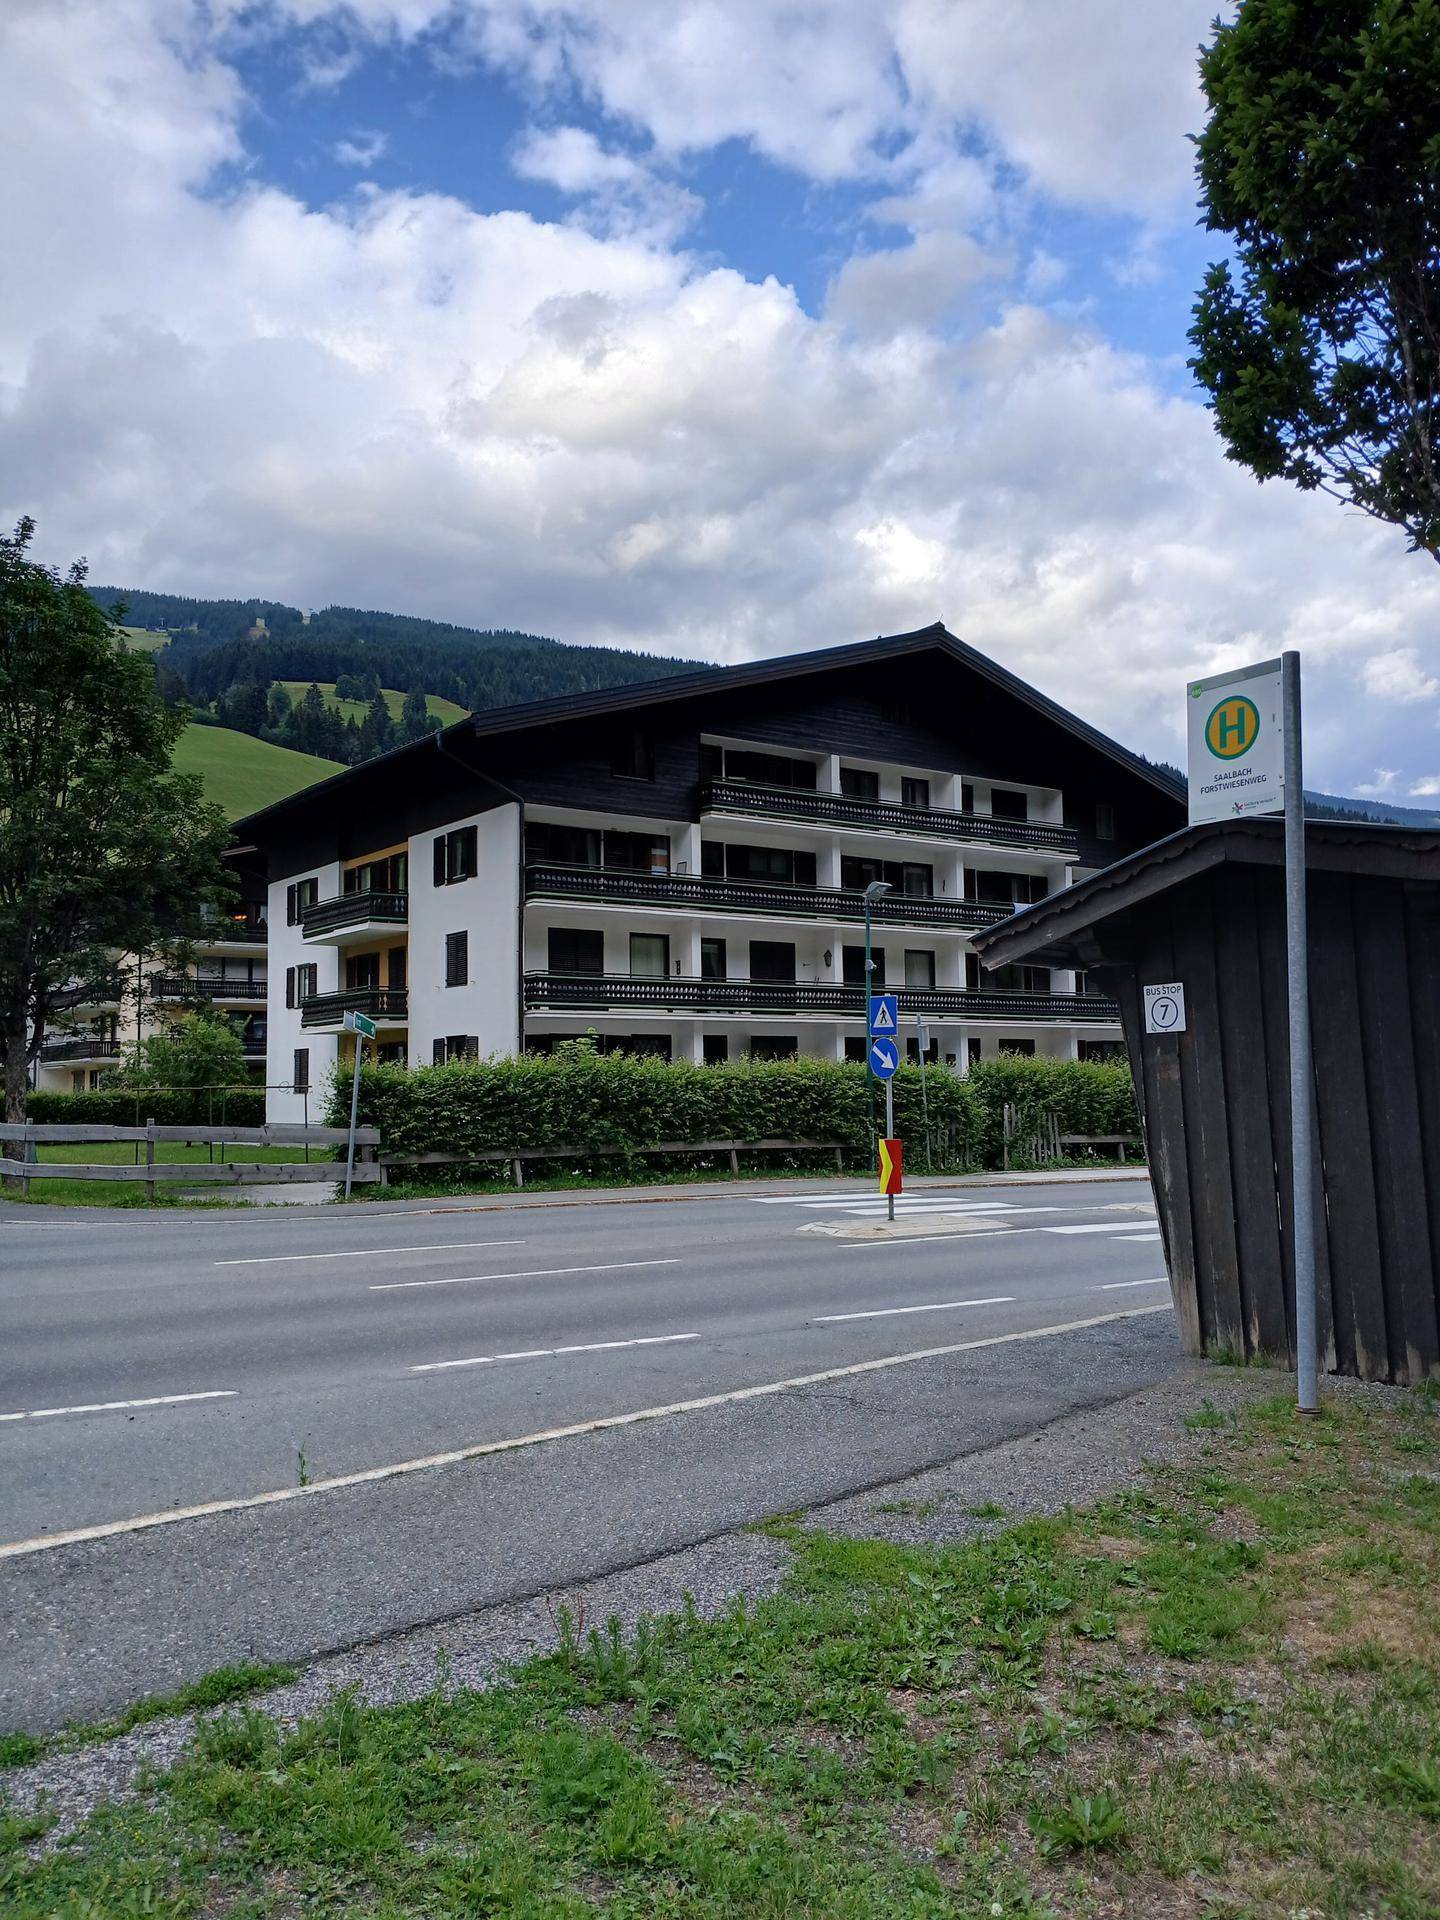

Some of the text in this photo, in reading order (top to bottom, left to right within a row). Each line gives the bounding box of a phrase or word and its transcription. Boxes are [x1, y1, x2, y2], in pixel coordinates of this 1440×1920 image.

[1219, 706, 1245, 749] H
[1213, 768, 1252, 782] SAALBACH
[1200, 774, 1267, 794] FORSTWIESENWEG
[1146, 985, 1181, 996] BUS STOP
[1160, 1004, 1169, 1020] 7
